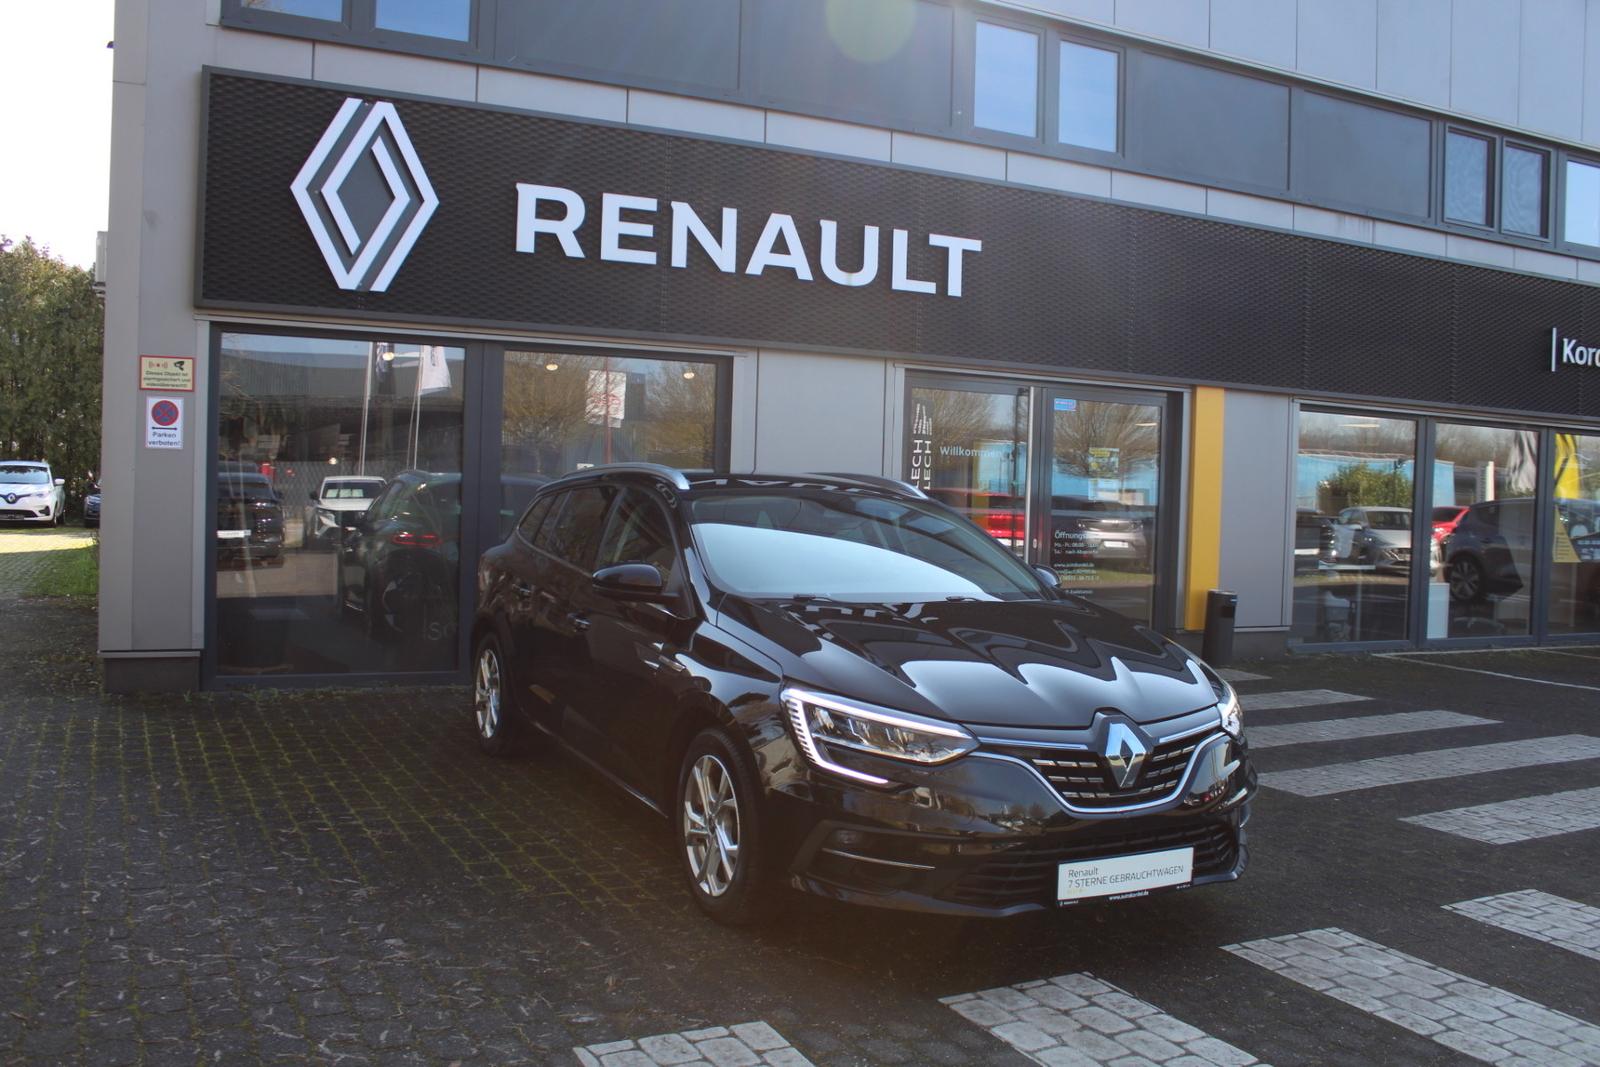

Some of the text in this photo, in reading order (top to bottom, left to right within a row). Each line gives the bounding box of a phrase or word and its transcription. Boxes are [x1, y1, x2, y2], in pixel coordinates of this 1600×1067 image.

[515, 182, 983, 298] RENAULT
[1068, 867, 1099, 879] Renault
[1068, 865, 1184, 888] 7 STERNE GEBRAUCHTWAGEN
